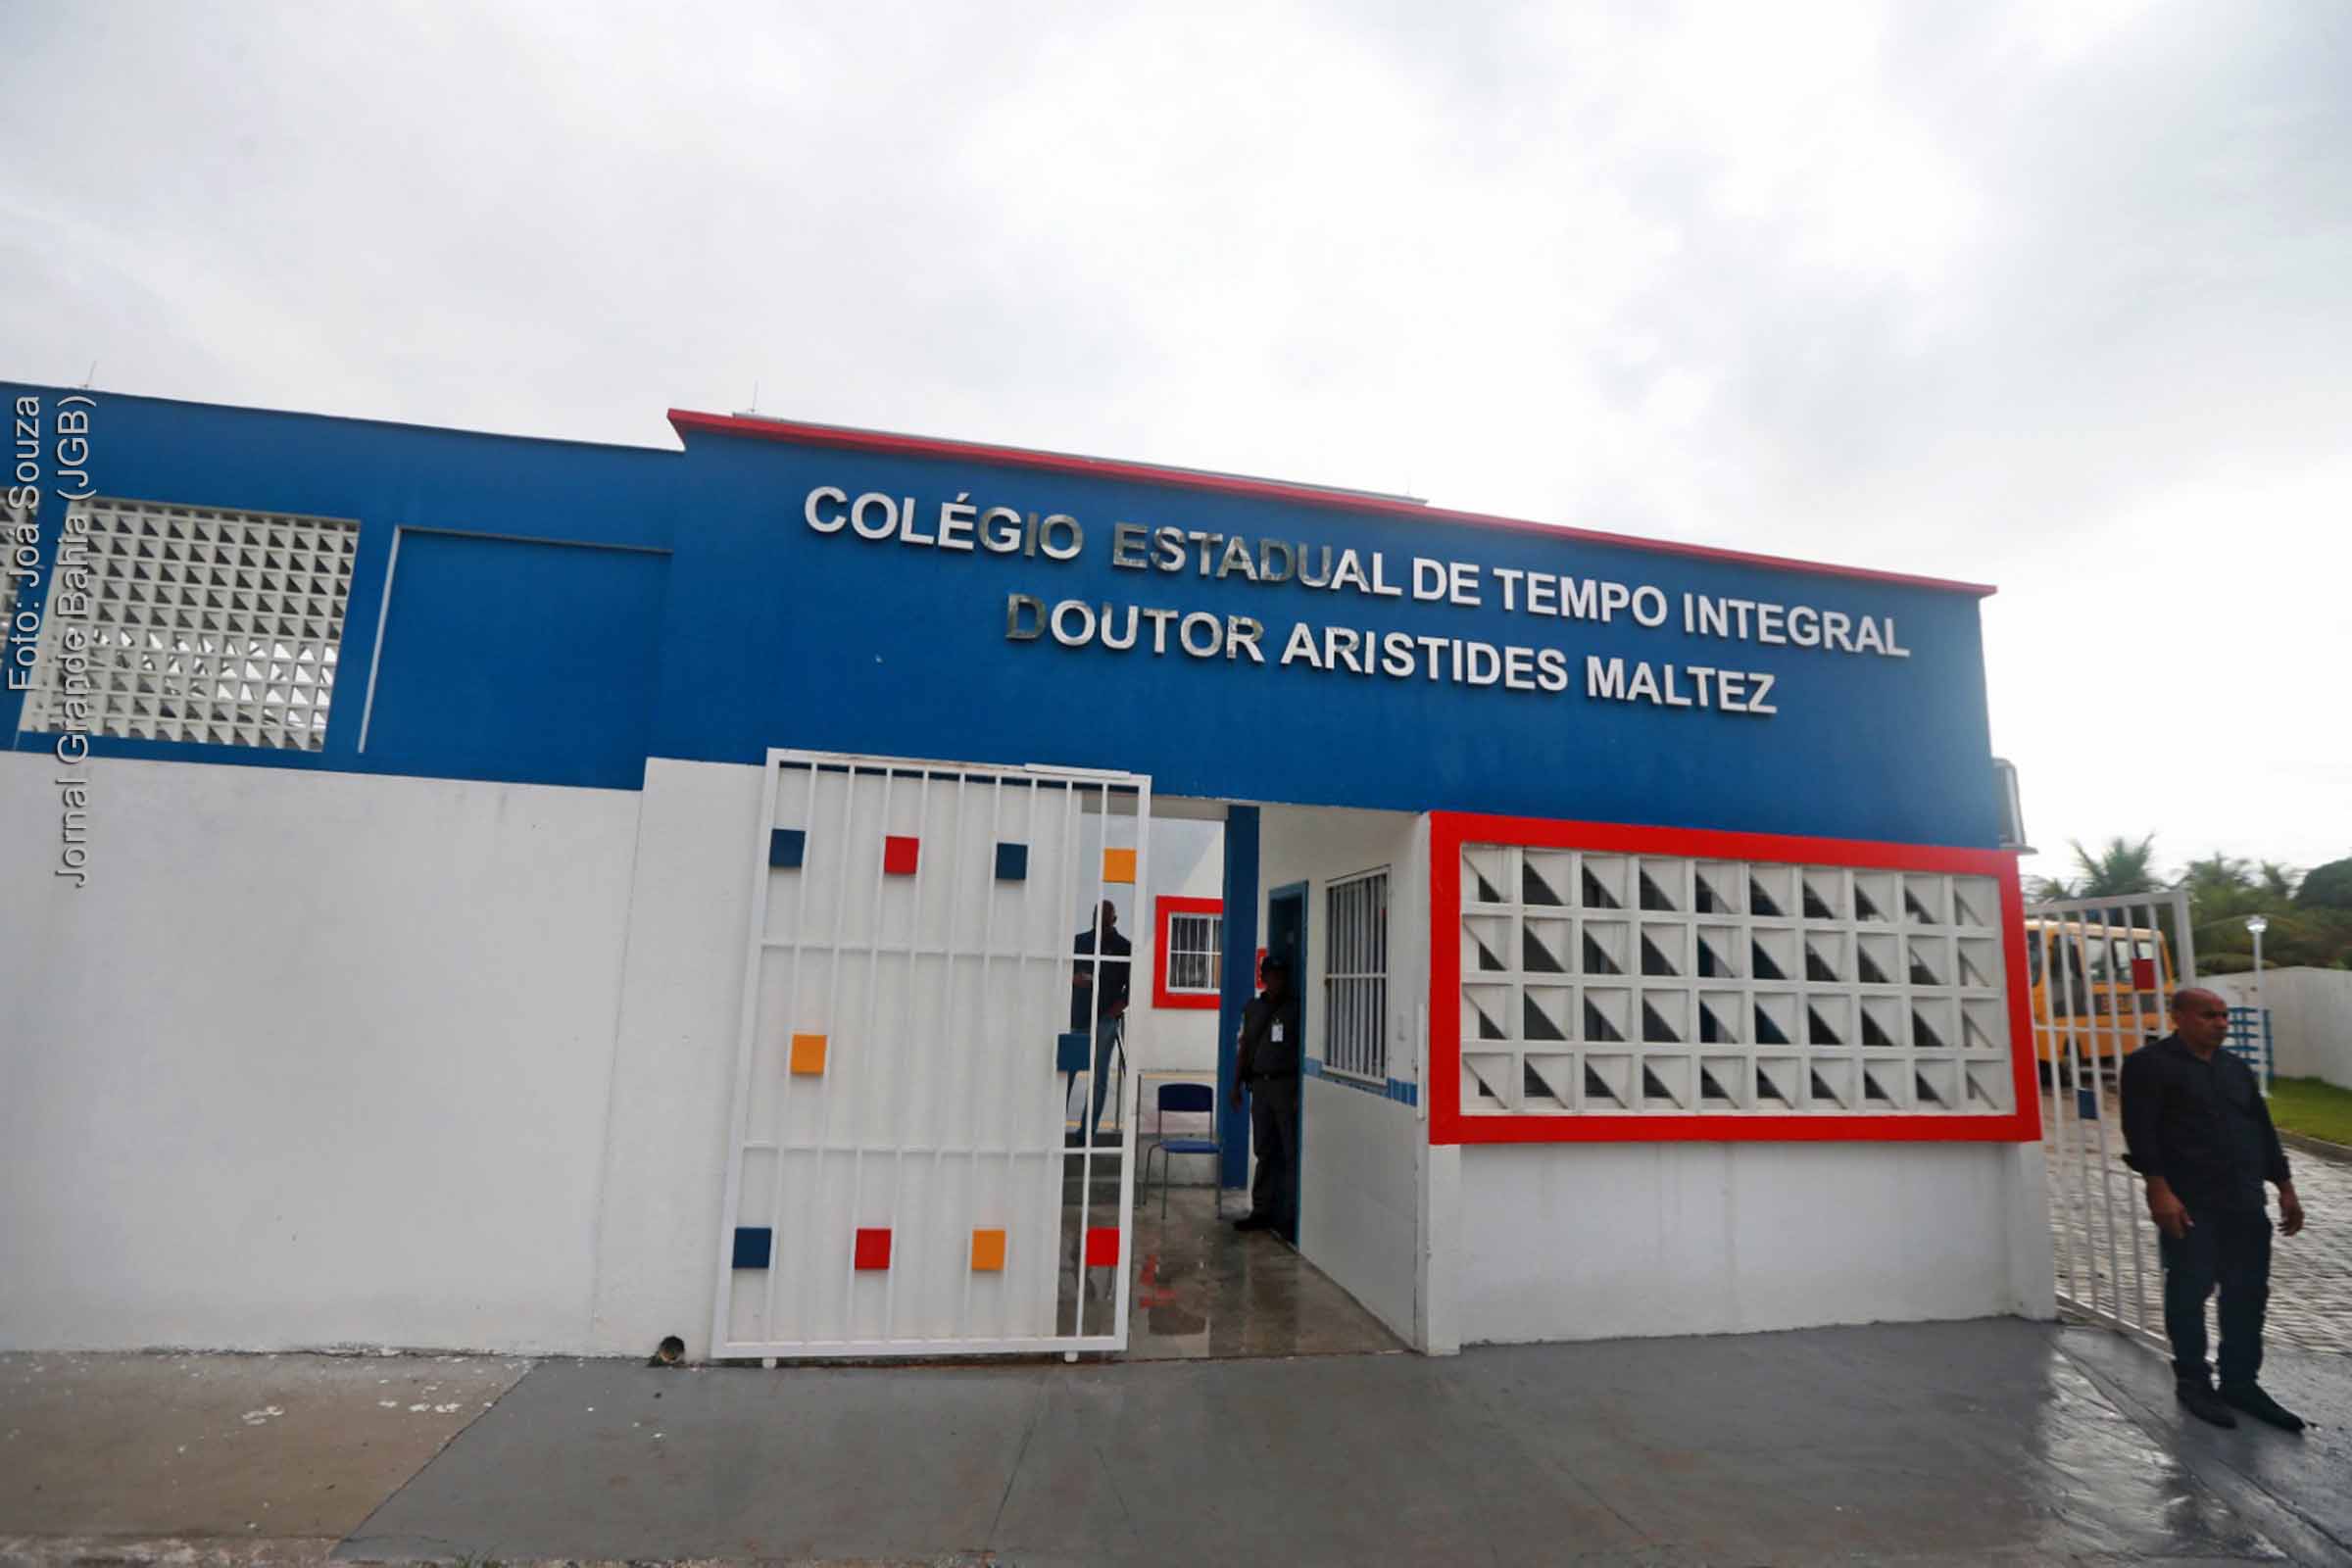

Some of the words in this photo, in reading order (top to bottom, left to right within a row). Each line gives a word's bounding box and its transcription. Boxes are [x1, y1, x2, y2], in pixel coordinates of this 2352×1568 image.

[804, 485, 1084, 561] COLÉGIO
[1112, 520, 1403, 596] ESTADUAL
[1412, 556, 1482, 607] DE
[1493, 566, 1668, 628] TEMPO
[1683, 592, 1911, 658] INTEGRAL
[1005, 591, 1266, 663] DOUTOR
[1280, 621, 1568, 692] ARISTIDES
[1585, 655, 1778, 715] MALTEZ
